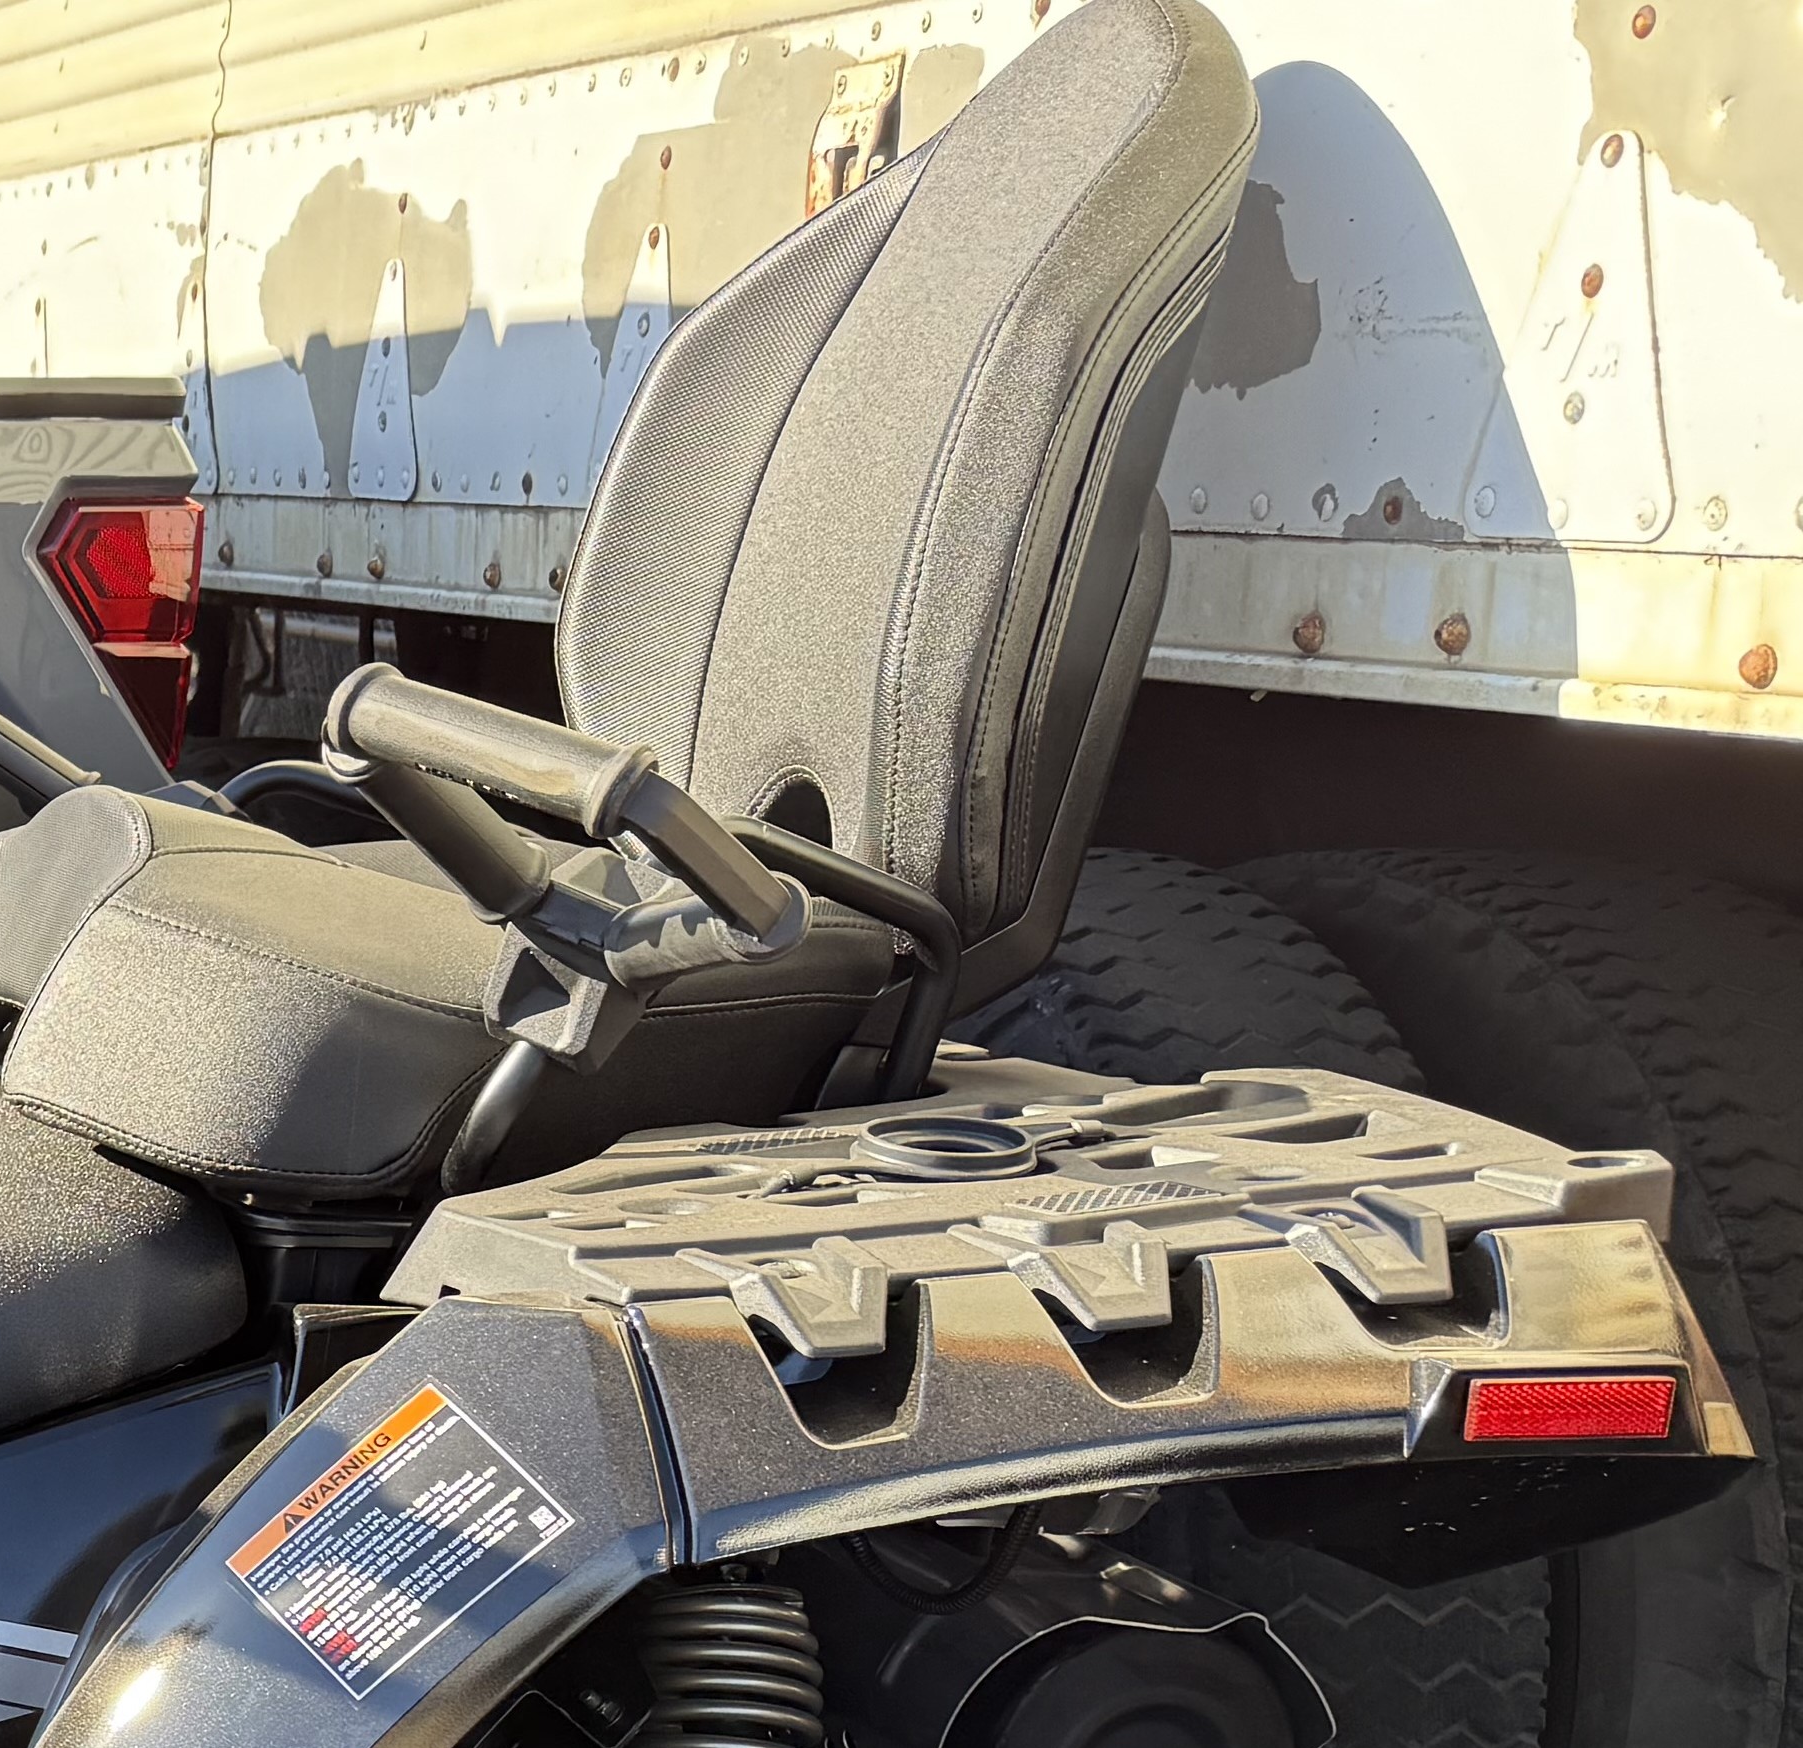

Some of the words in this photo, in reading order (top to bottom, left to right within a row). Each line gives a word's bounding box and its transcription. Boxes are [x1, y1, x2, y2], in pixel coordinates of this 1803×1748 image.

[297, 1429, 392, 1513] WARNING
[316, 1546, 332, 1561] 7.0
[323, 1553, 340, 1569] 7.0
